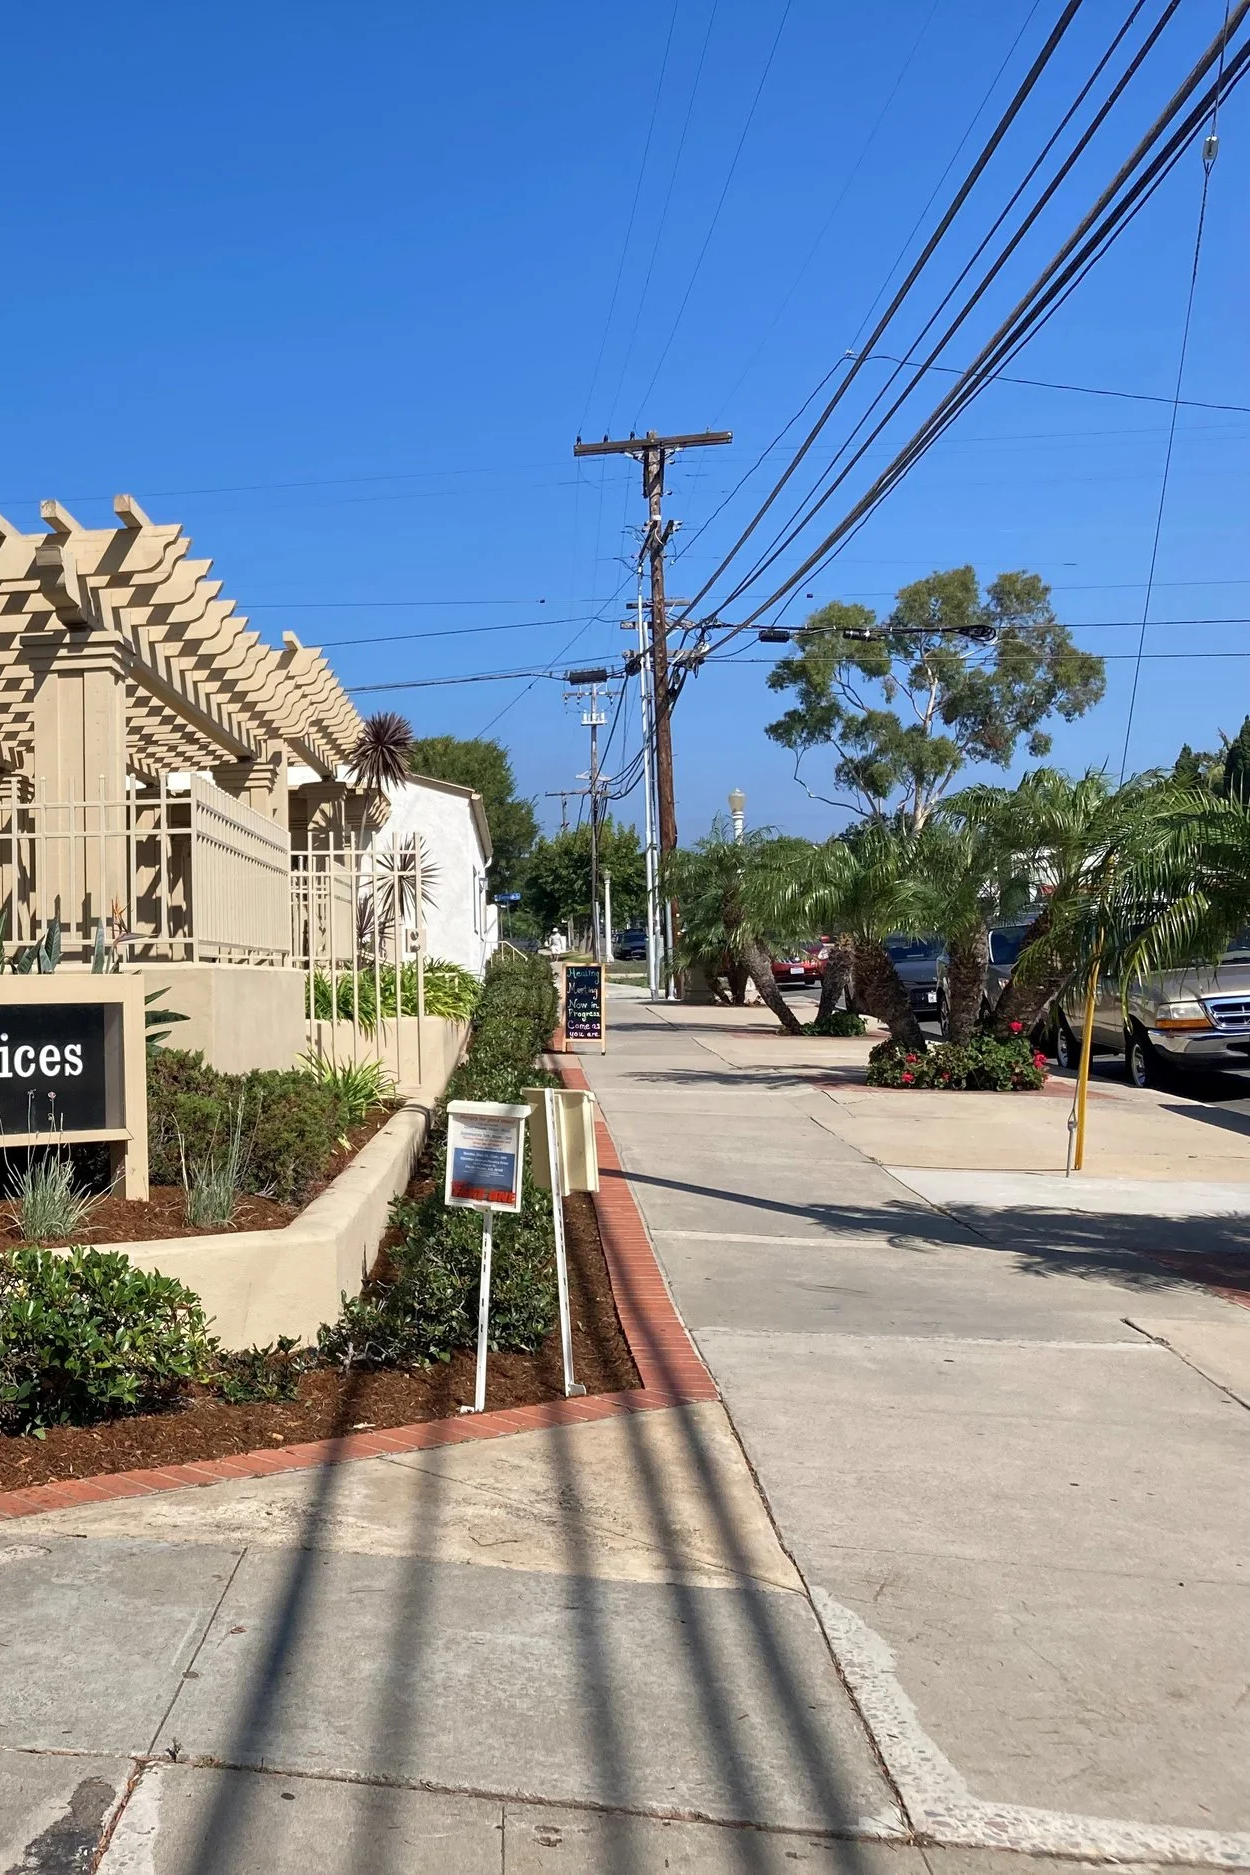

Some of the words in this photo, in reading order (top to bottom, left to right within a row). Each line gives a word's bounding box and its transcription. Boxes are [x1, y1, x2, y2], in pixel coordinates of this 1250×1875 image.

[567, 967, 600, 985] Healing
[567, 999, 588, 1009] Now
[590, 1001, 600, 1009] in
[568, 1008, 601, 1022] Progress
[567, 1019, 591, 1030] Come
[591, 1022, 601, 1030] as
[569, 1031, 585, 1039] you
